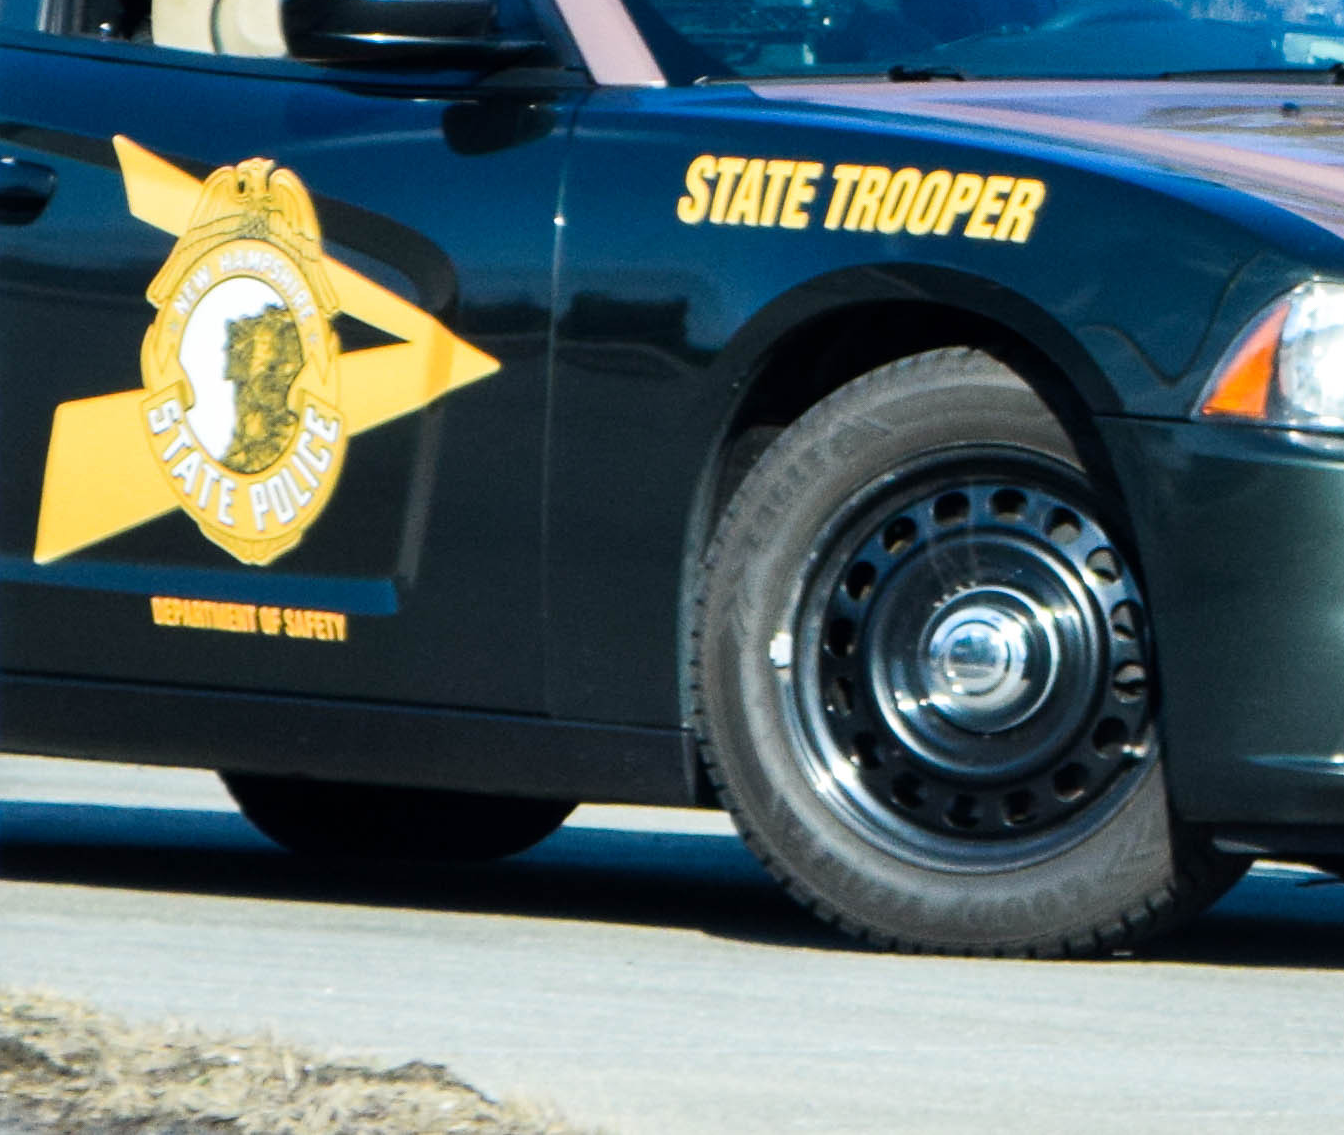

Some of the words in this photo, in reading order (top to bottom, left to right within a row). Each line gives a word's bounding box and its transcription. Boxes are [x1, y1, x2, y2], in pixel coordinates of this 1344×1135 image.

[676, 154, 825, 229] STATE
[823, 163, 1047, 244] TROOPER
[173, 265, 211, 315] NEW
[220, 250, 316, 323] HAMPSHIRE
[148, 398, 236, 527] STATE
[249, 405, 341, 532] POLICE
[150, 595, 257, 634] DEPARTMENT
[258, 605, 282, 636] OF
[282, 607, 346, 642] SAFETY
